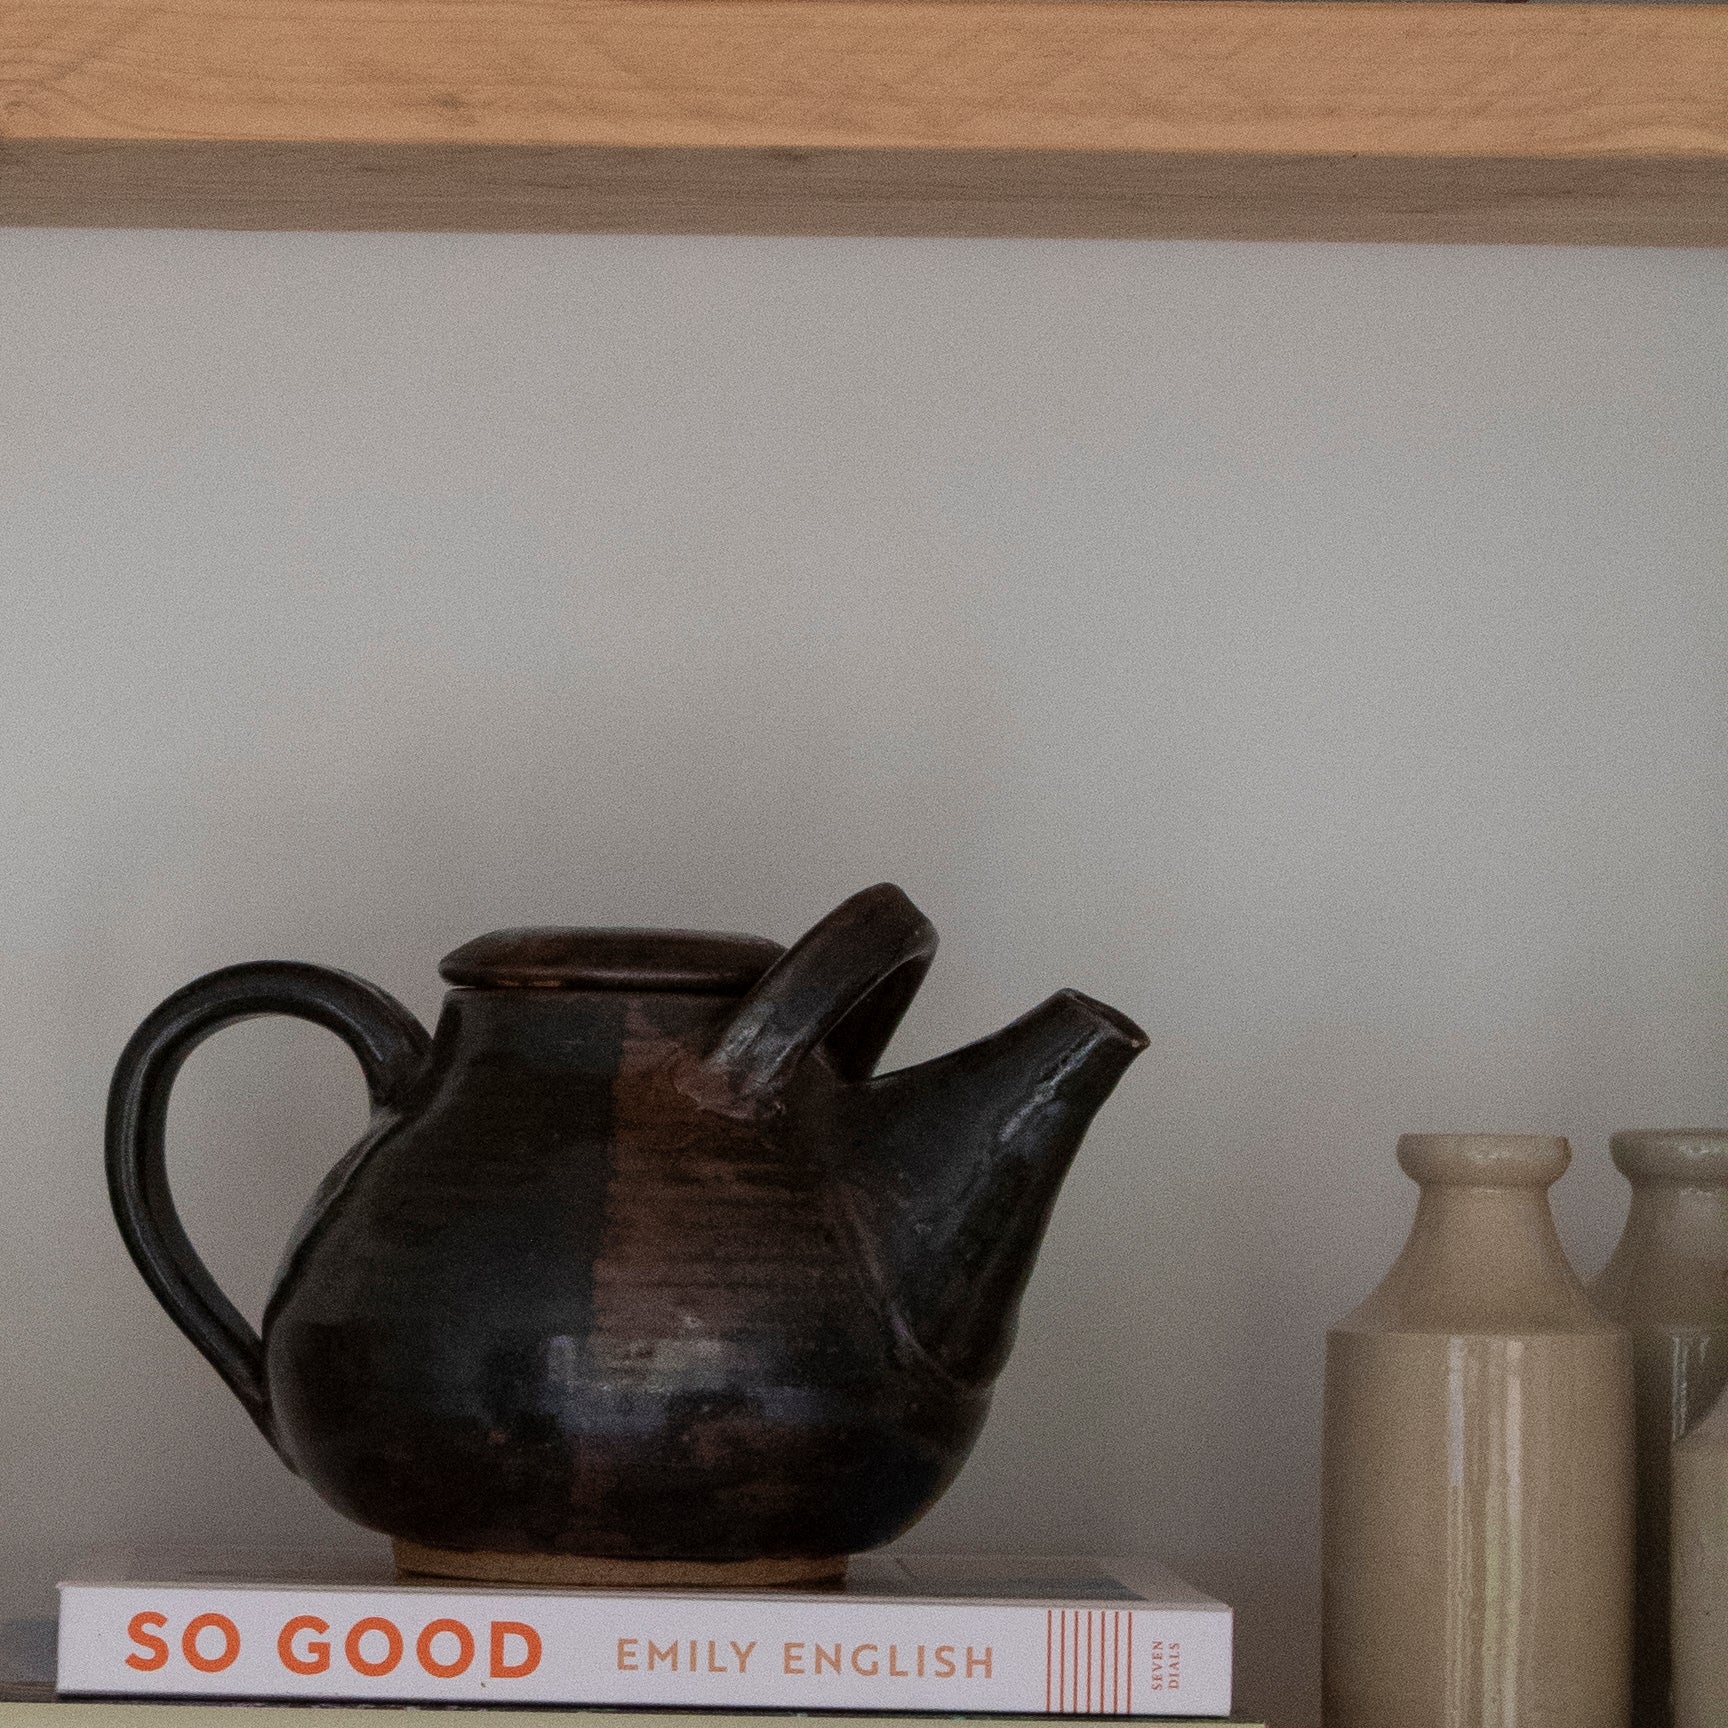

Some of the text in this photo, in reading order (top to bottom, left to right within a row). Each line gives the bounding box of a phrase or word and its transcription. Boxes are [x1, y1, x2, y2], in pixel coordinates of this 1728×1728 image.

[125, 1611, 543, 1679] SO GOOD
[617, 1638, 994, 1679] EMILY ENGLISH
[1151, 1639, 1163, 1691] SEVEN
[1167, 1642, 1180, 1690] DIALS
